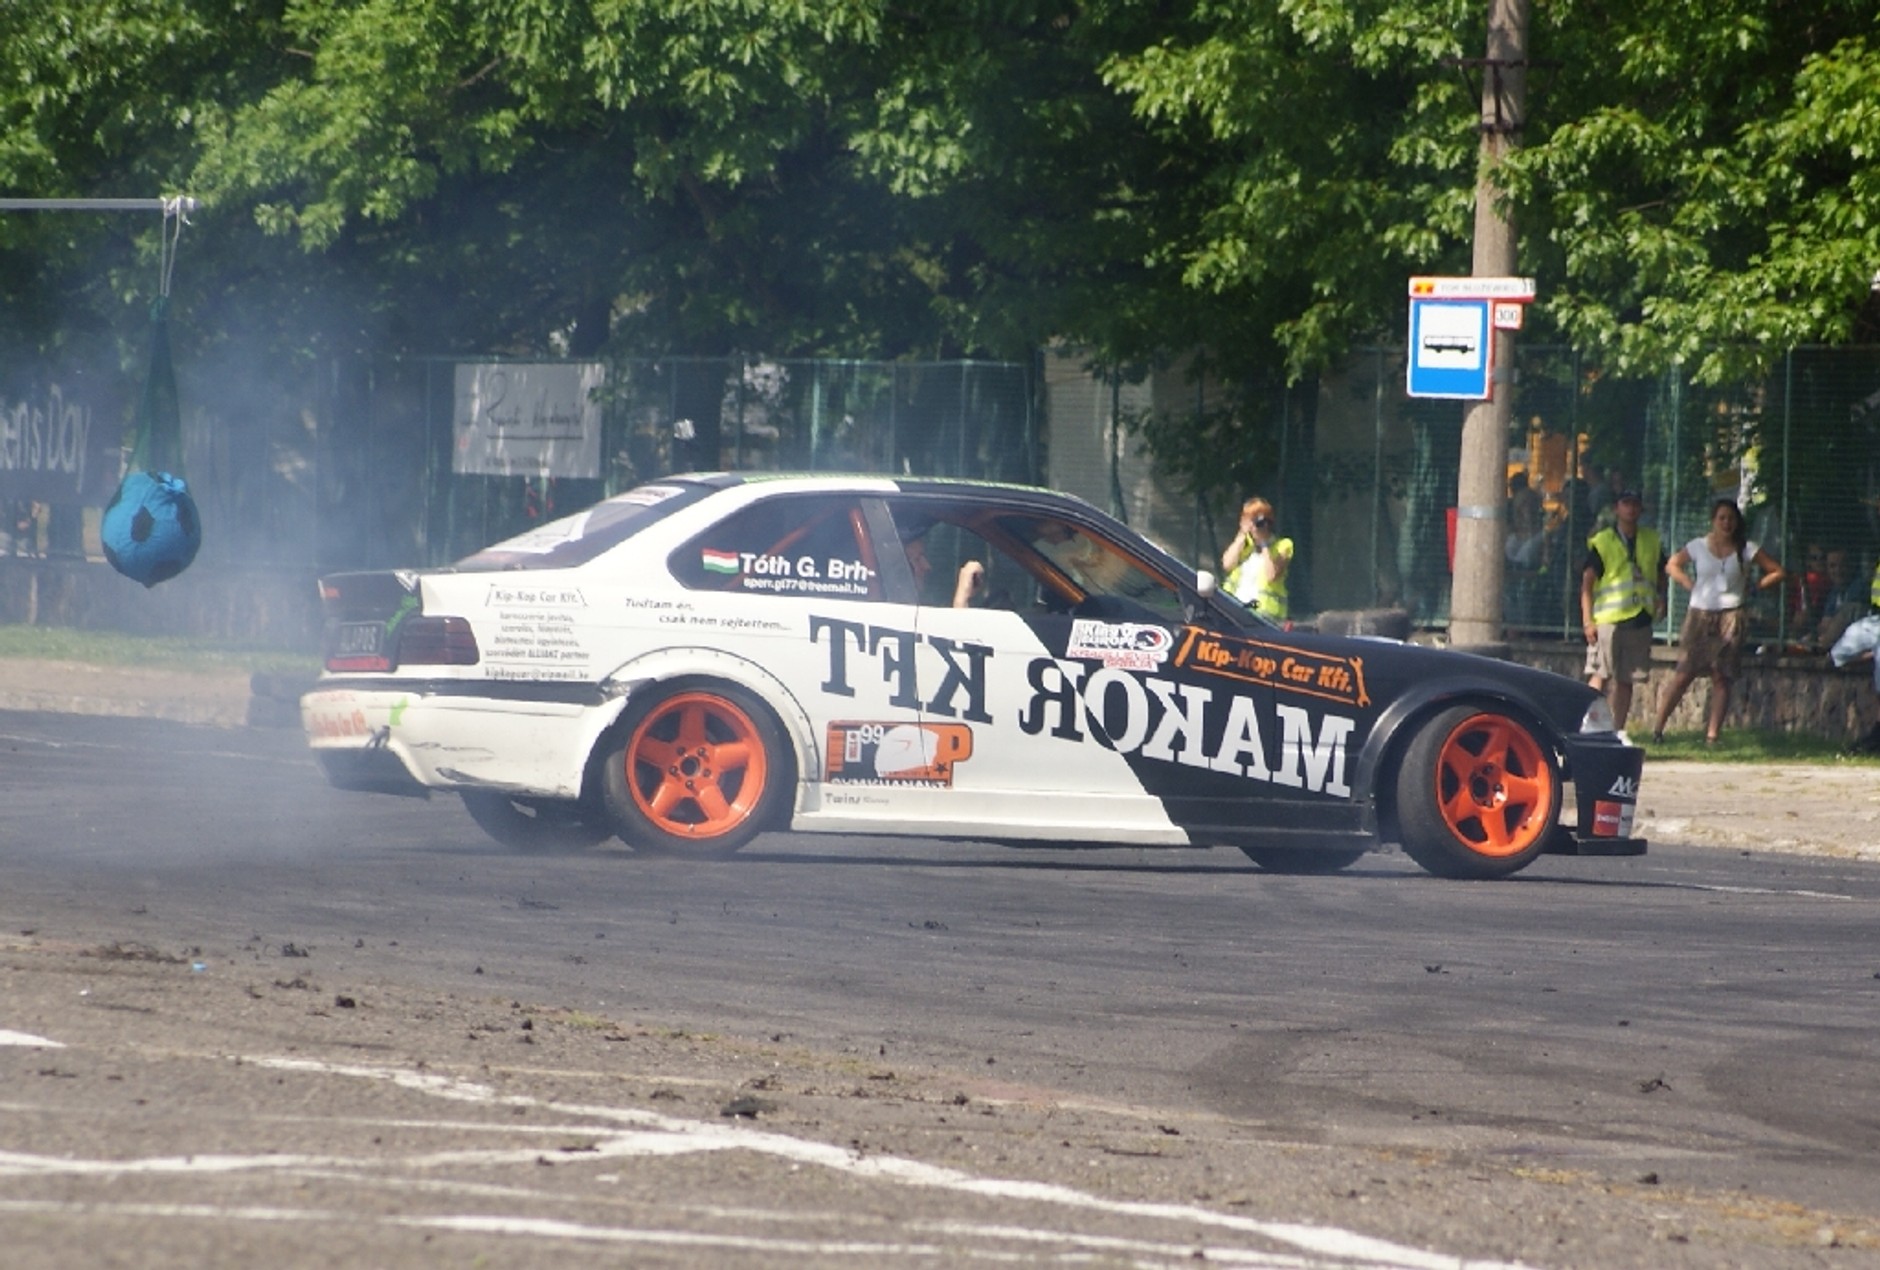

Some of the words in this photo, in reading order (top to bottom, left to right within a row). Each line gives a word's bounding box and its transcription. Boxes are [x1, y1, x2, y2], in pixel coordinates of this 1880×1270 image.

[739, 552, 790, 575] Tóth
[797, 556, 820, 578] G.
[828, 558, 876, 581] Brh-
[690, 615, 717, 625] nem
[1197, 640, 1277, 678] Kip-Kop
[1281, 657, 1315, 683] Car
[1318, 664, 1353, 693] Kft.
[860, 723, 885, 745] 99
